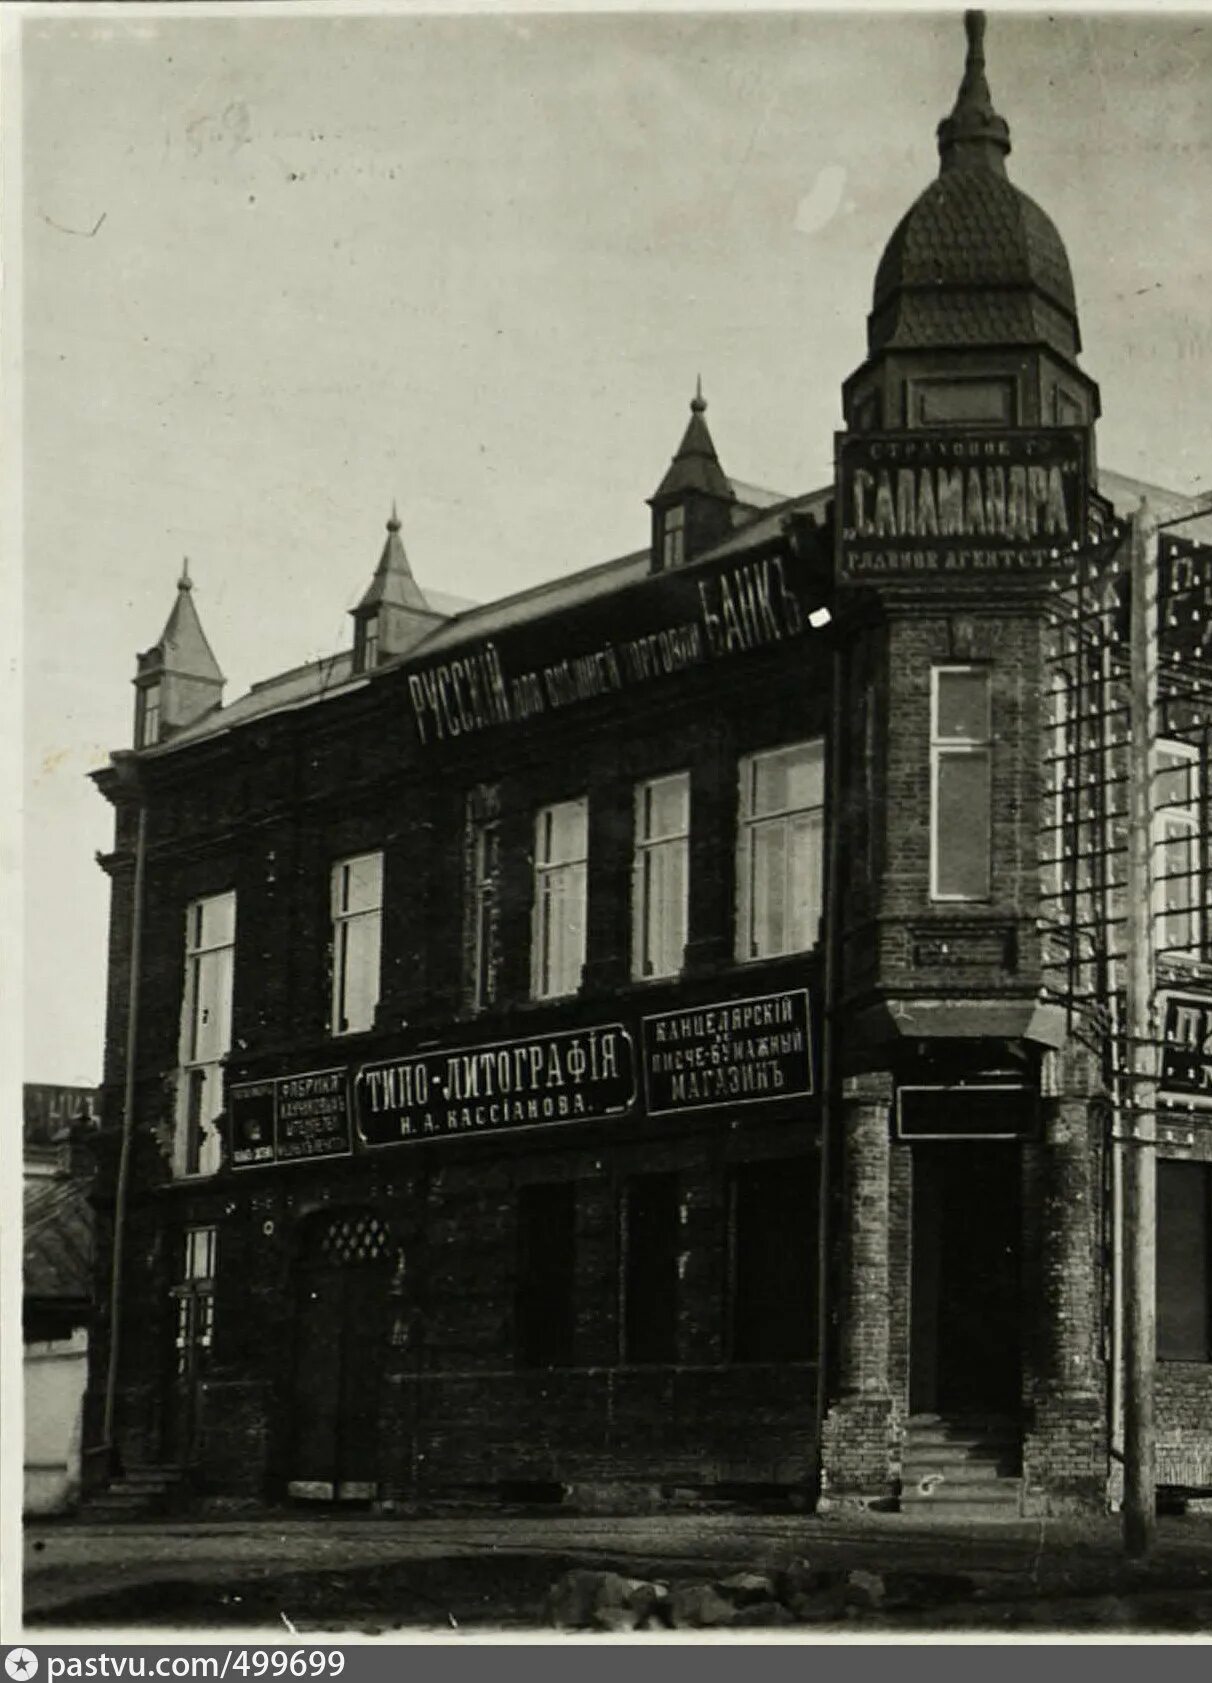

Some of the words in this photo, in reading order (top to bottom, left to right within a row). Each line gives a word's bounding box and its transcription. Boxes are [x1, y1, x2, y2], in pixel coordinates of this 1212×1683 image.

[408, 641, 510, 745] РУССКІЙ
[697, 555, 801, 658] БАНКЪ
[655, 996, 794, 1043] КАНЦЕЛЯРСКІЙ
[670, 1059, 785, 1102] МАГАЗИНЪ
[423, 1112, 441, 1134] А.
